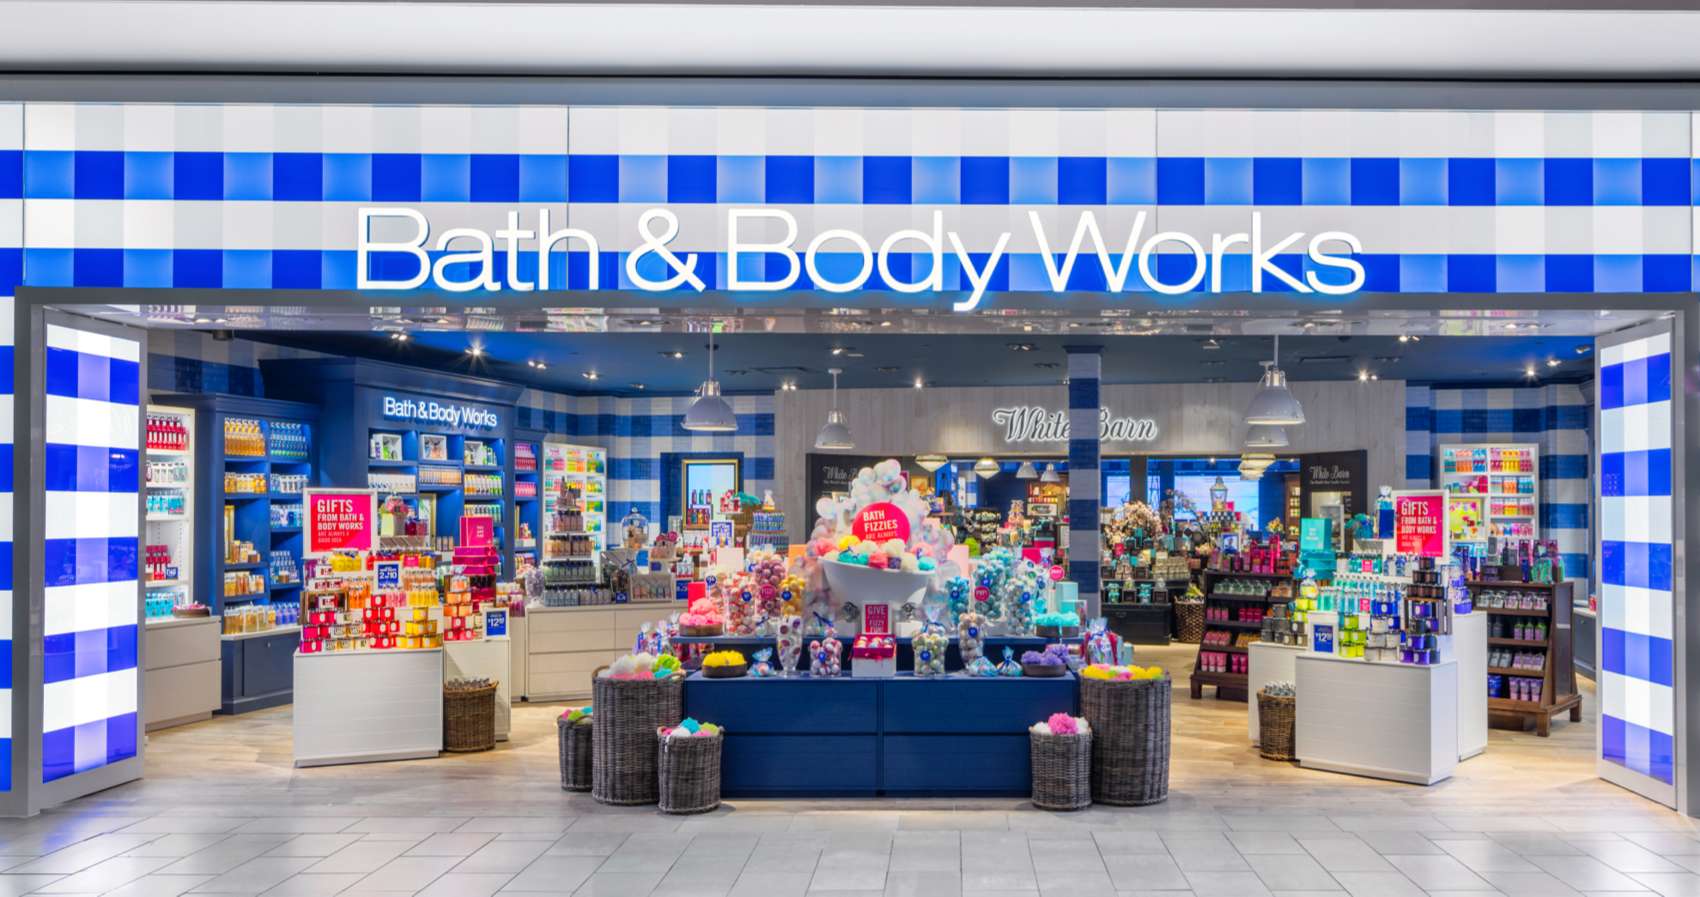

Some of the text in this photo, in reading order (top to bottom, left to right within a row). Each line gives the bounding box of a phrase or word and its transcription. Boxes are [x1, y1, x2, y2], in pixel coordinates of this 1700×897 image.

[357, 207, 1366, 312] Bath & Body Works
[384, 396, 497, 426] Bath & Body Works
[992, 406, 1070, 441] White
[317, 499, 353, 513] GIFTS
[1401, 501, 1429, 515] GIFTS
[318, 513, 338, 521] FROM
[339, 513, 358, 521] BATH
[863, 510, 885, 521] BATH
[1401, 516, 1417, 525] FROM
[1418, 516, 1431, 525] BATH
[317, 522, 364, 530] BODY WORKS
[864, 519, 898, 532] FIZZIES
[1401, 525, 1437, 534] BODY WORKS
